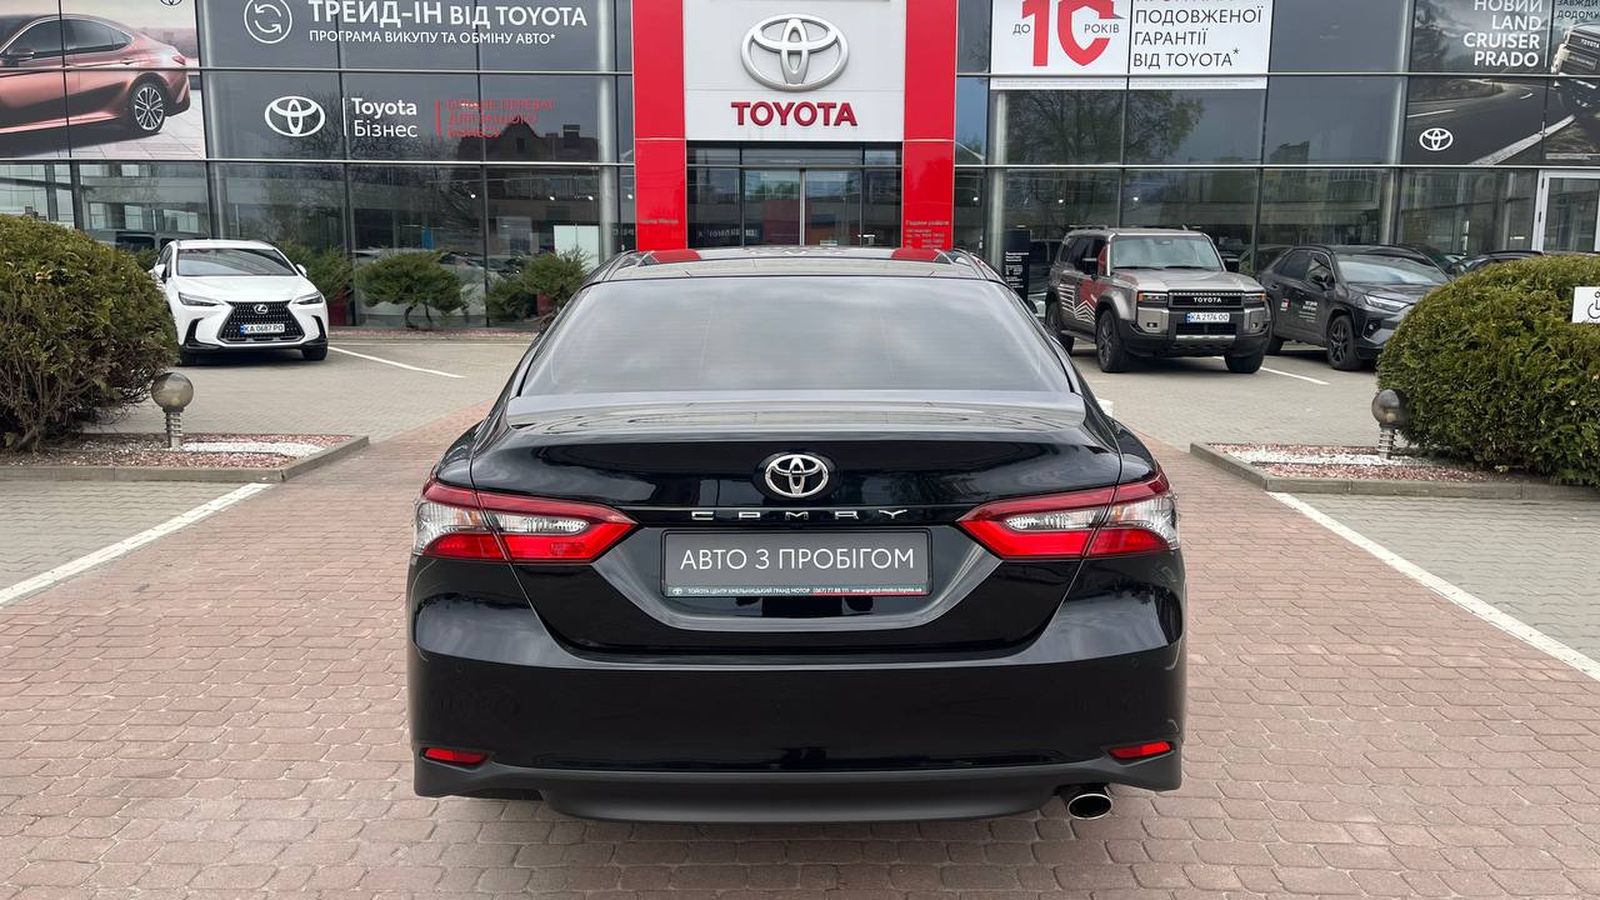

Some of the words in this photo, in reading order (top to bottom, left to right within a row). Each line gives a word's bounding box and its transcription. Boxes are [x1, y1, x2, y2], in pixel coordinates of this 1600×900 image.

[450, 6, 490, 29] ВІД
[495, 7, 587, 26] TOYOTA
[1135, 5, 1264, 25] ПОДОВЖЕНОЇ
[1491, 15, 1542, 31] LAND
[310, 30, 381, 42] ПРОГРАМА
[385, 31, 438, 43] ВИКУПУ
[441, 32, 457, 43] ТА
[460, 32, 513, 44] ОБМІНУ
[1013, 24, 1031, 36] ДО
[1084, 24, 1120, 34] РОКІВ
[1134, 28, 1207, 46] ГАРАНТІЇ
[1463, 32, 1540, 49] CRUISER
[1133, 53, 1161, 70] ВІД
[1474, 51, 1539, 67] PRADO
[351, 98, 417, 119] Toyota
[731, 101, 858, 127] TOYOTA
[354, 119, 418, 138] Бізнес
[691, 509, 908, 520] CAMRY
[680, 549, 747, 570] АВТО
[780, 548, 914, 569] ПРОБІГОМ
